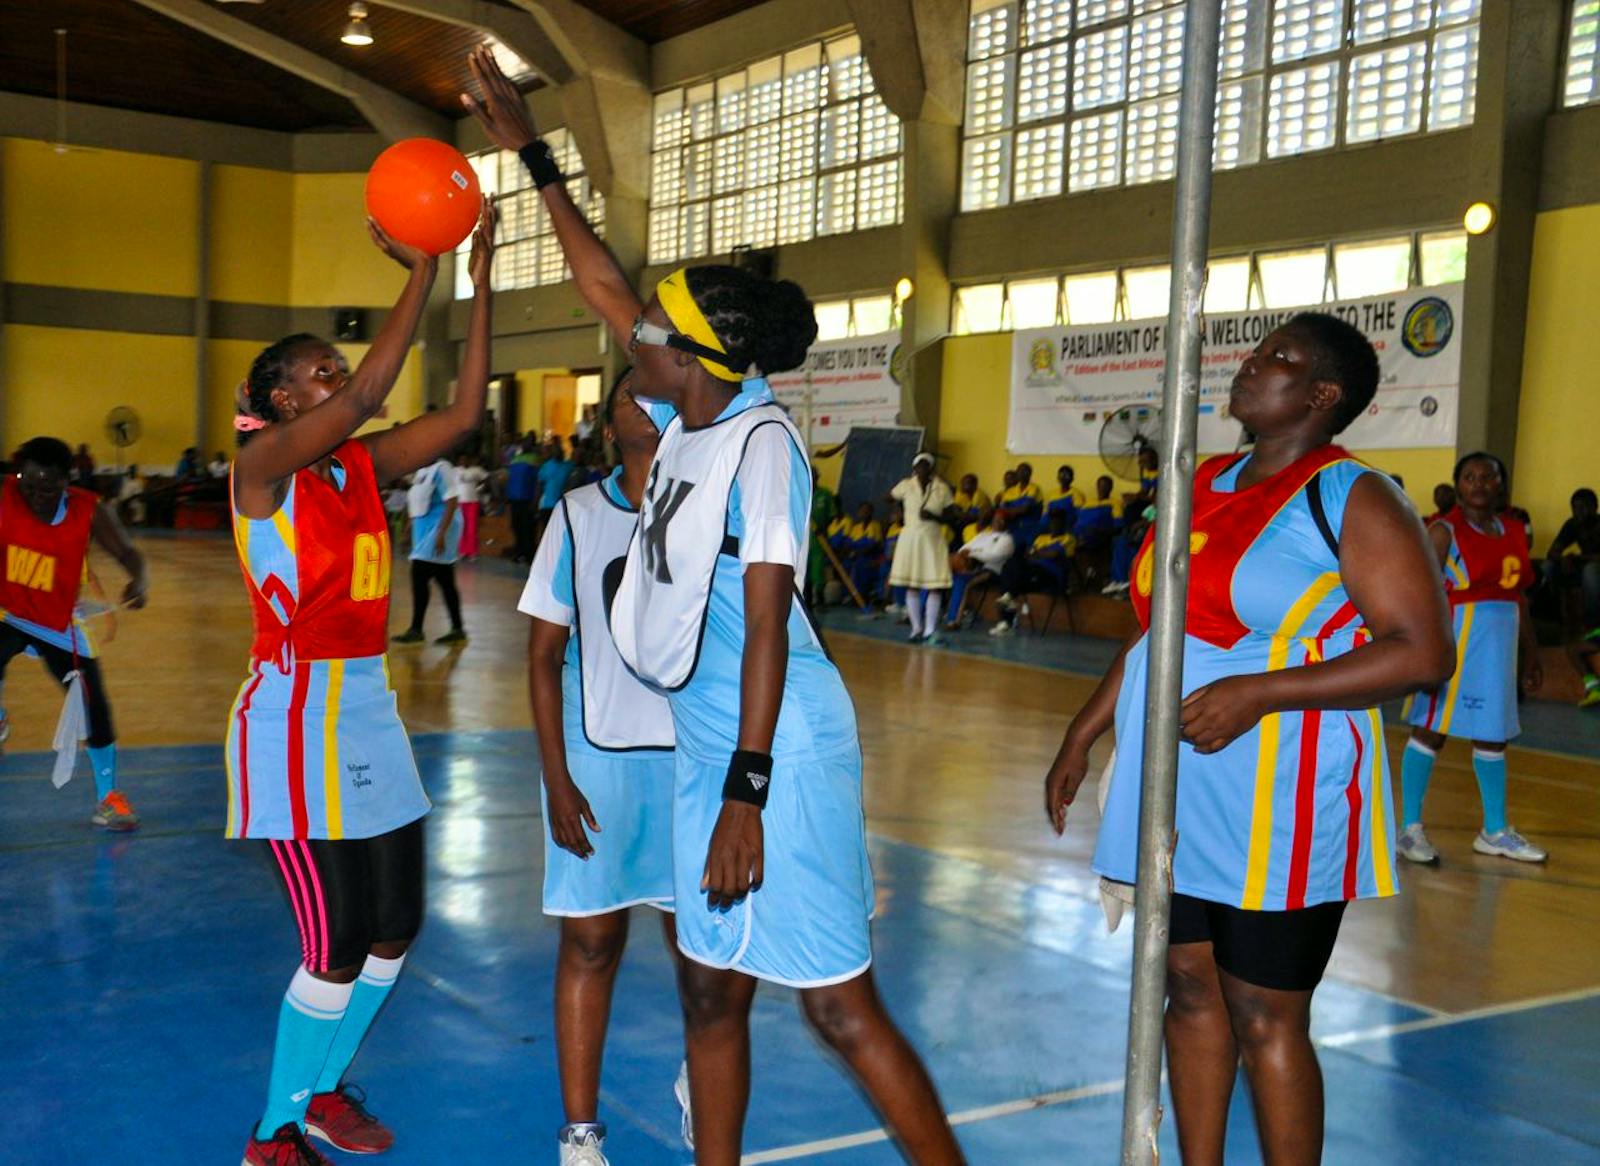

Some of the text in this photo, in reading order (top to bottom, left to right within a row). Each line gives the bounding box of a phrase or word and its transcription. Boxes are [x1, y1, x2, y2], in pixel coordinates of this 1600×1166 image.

[1061, 329, 1140, 360] PARLIAMENT
[1143, 326, 1160, 352] OF
[1212, 312, 1294, 346] WELCOM
[1363, 301, 1396, 333] THE
[7, 544, 56, 593] WA
[1499, 555, 1521, 589] C
